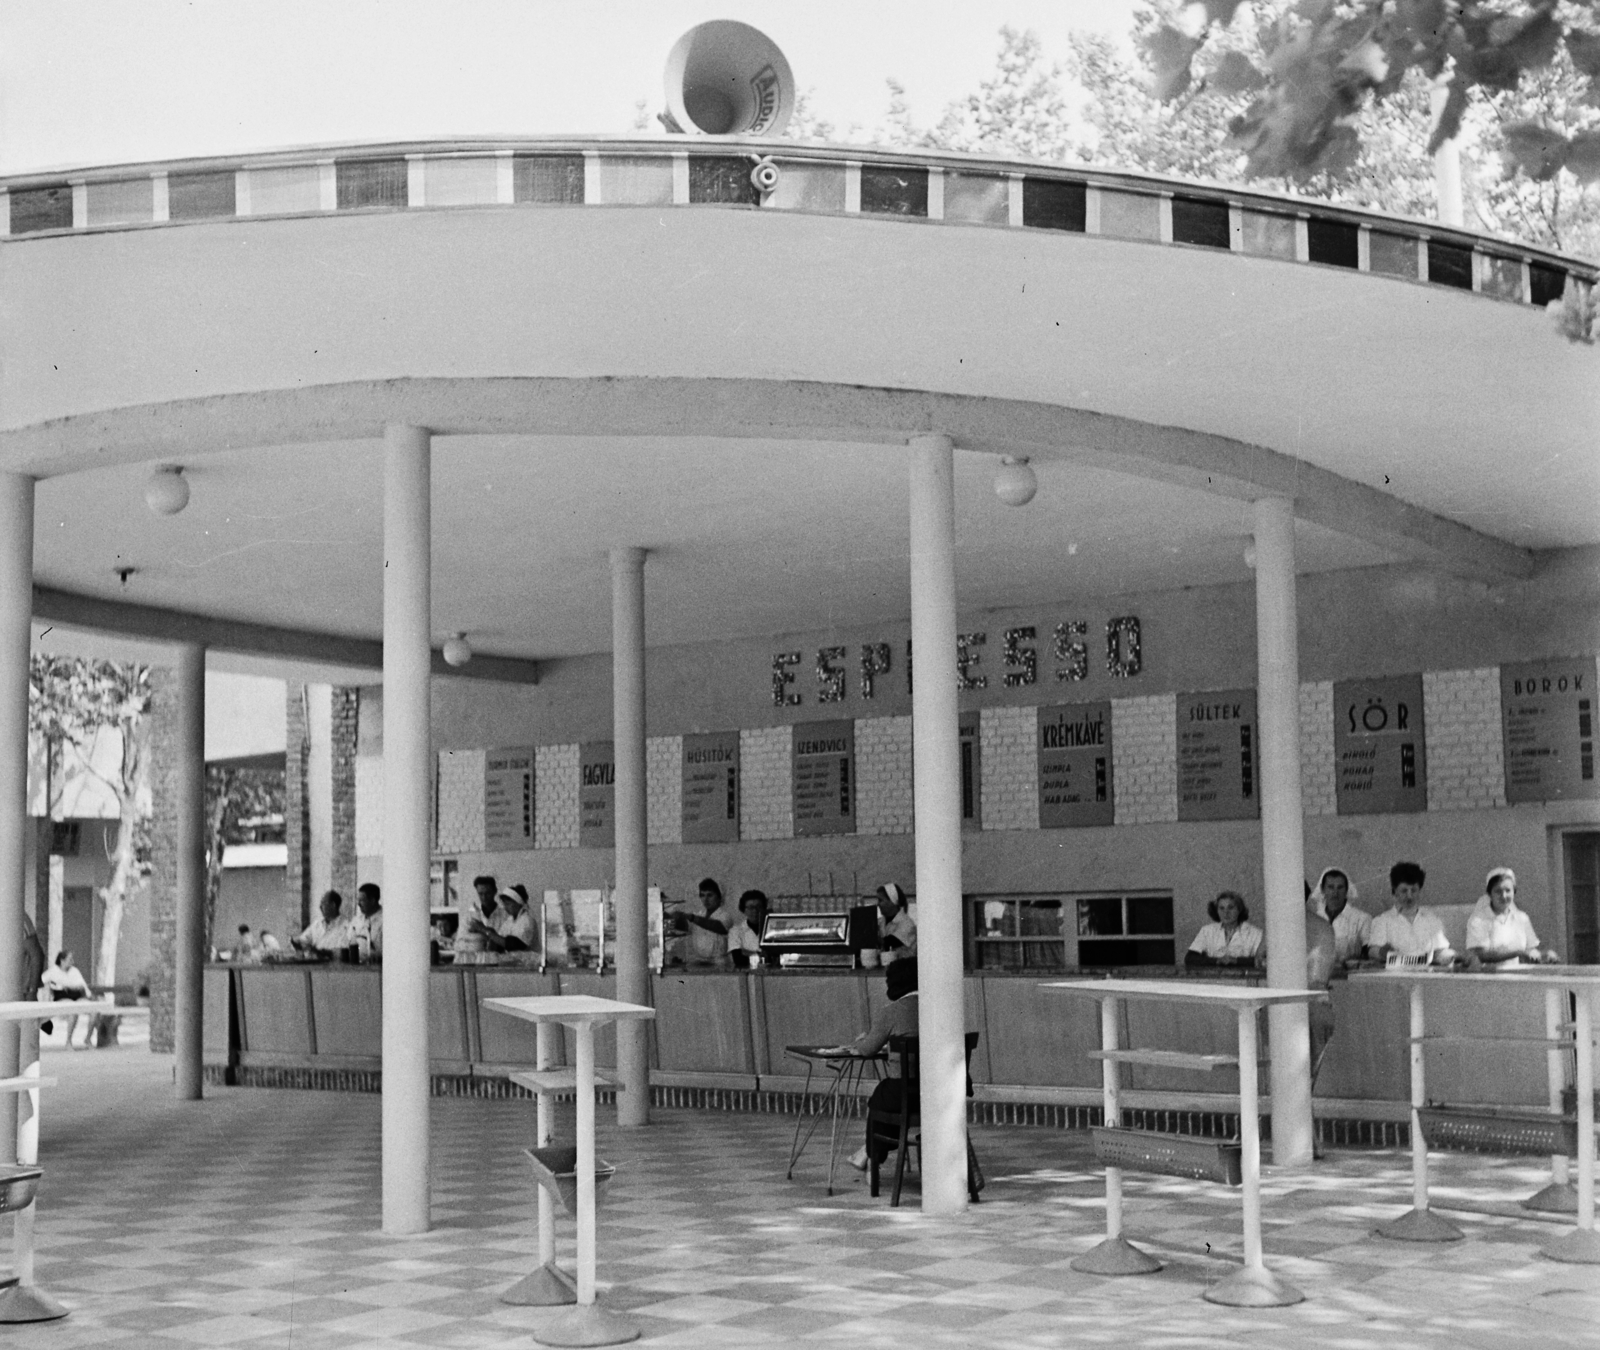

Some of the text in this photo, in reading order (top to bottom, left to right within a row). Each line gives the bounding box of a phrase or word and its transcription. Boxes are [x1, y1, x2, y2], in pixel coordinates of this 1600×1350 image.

[772, 616, 1141, 707] ESPESSO
[1513, 674, 1583, 696] BOROK
[1348, 697, 1409, 733] SÖR
[1043, 711, 1105, 748] KRÉMKÁVÉ
[797, 738, 847, 755] SZENDVICS
[1043, 763, 1071, 774] SZIMPLA
[1043, 779, 1069, 789] DUPLA
[1044, 794, 1061, 805] HAB
